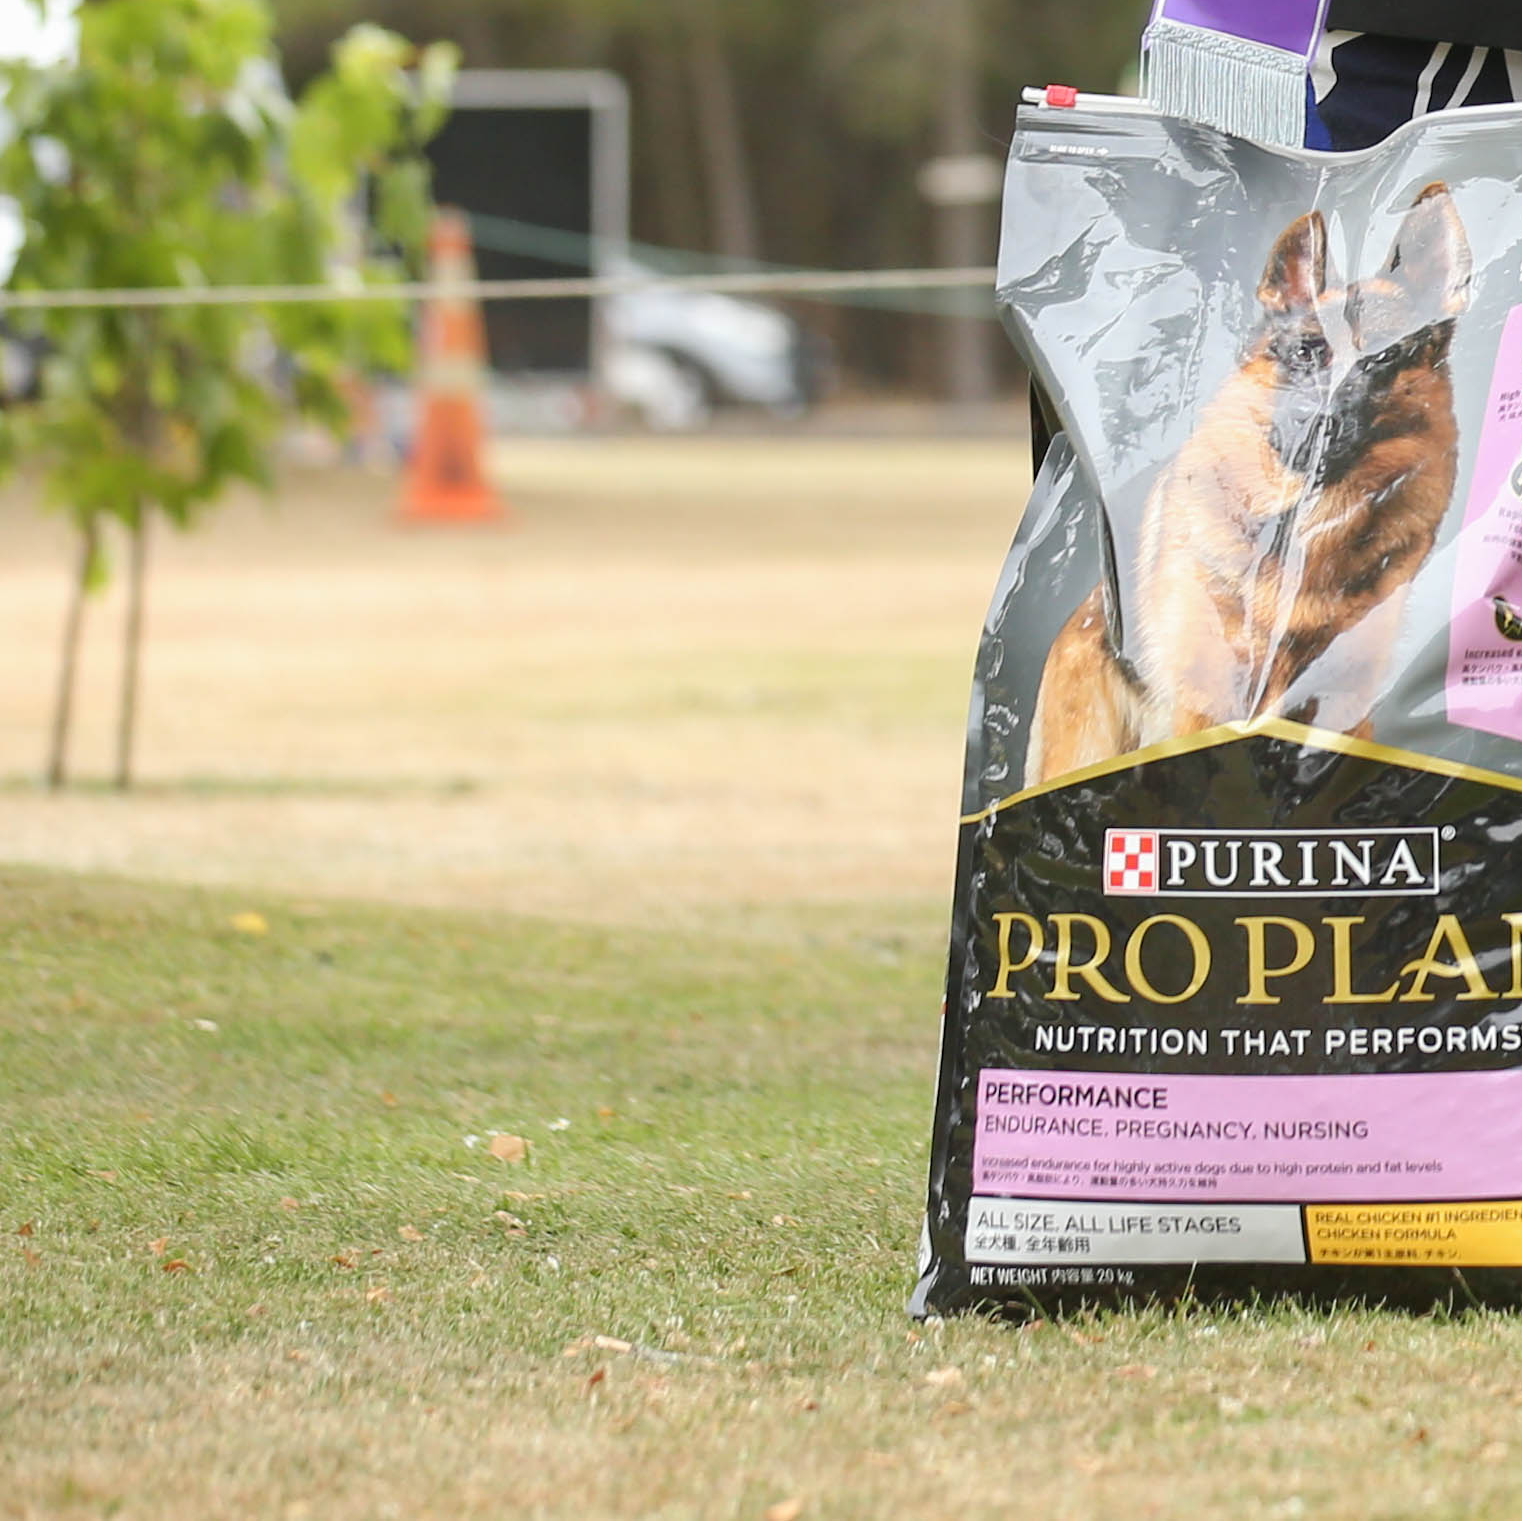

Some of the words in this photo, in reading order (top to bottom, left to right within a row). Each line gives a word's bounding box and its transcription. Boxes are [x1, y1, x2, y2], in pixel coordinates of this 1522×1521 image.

[1166, 838, 1426, 886] PURINA
[986, 912, 1212, 1003] PRO
[1034, 1025, 1208, 1054] NUTRITION
[1220, 1029, 1311, 1055] THAT
[984, 1081, 1169, 1109] PERFORMANCE
[984, 1114, 1109, 1138] ENDURANCE,
[1116, 1120, 1257, 1141] PREGNANCY,
[1264, 1120, 1369, 1140] NURSING
[1031, 1159, 1090, 1171] endurance
[1093, 1160, 1112, 1172] for
[1113, 1161, 1151, 1176] highly
[1154, 1162, 1192, 1174] active
[1194, 1163, 1226, 1176] dogs
[1229, 1162, 1255, 1175] due
[1257, 1162, 1270, 1175] to
[1274, 1161, 1302, 1177] high
[1306, 1162, 1353, 1177] protein
[1356, 1161, 1381, 1174] and
[1384, 1160, 1403, 1174] fat
[1405, 1160, 1444, 1173] levels
[977, 1210, 1010, 1229] ALL
[1065, 1215, 1105, 1234] ALL
[1108, 1216, 1153, 1234] LIFE
[1157, 1216, 1243, 1235] STAGES
[1315, 1211, 1353, 1224] REAL
[1356, 1211, 1422, 1224] CHICKEN
[1316, 1228, 1381, 1241] CHICKEN
[1384, 1228, 1458, 1240] FORMULA
[970, 1265, 996, 1286] NET
[996, 1266, 1049, 1286] WEIGHT
[1097, 1267, 1115, 1285] 20
